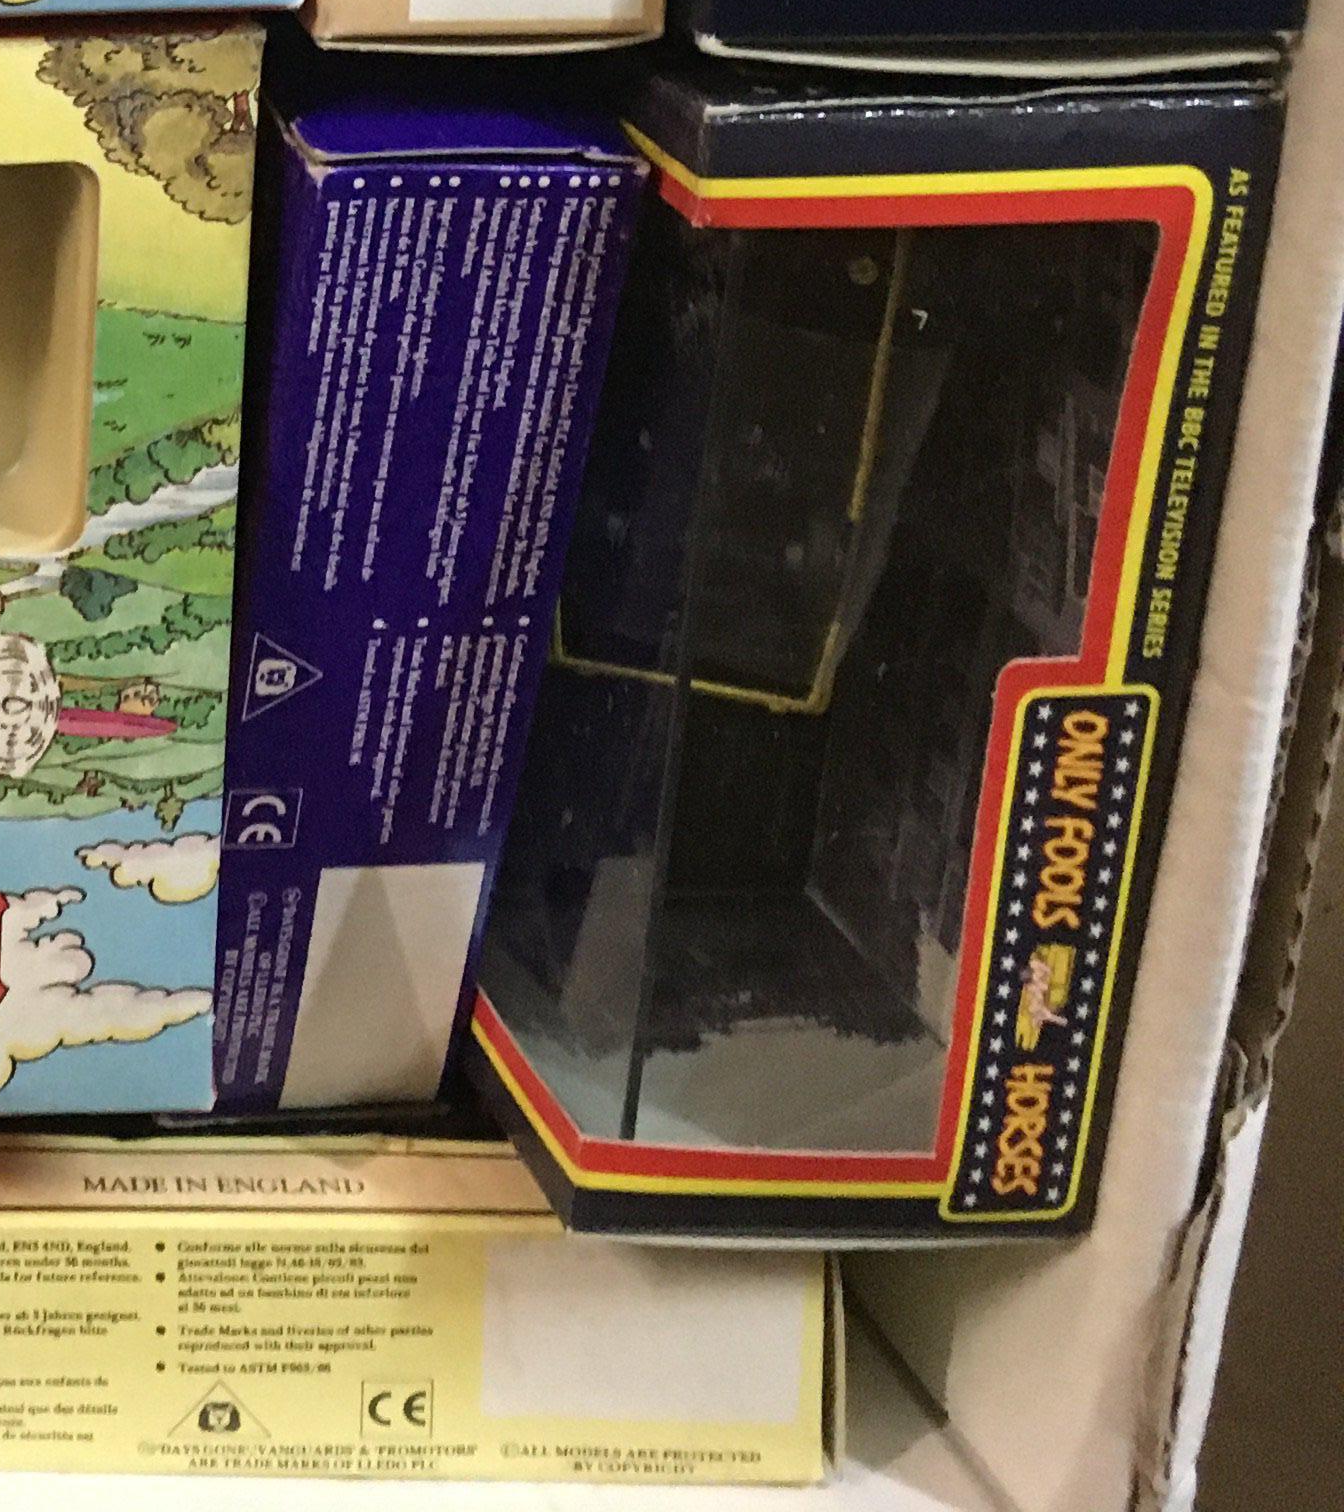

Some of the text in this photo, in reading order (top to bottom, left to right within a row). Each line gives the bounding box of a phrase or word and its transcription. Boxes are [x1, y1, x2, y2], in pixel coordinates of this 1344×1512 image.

[1142, 167, 1251, 658] AS FEATURED IN THE BBC TELEVISION SERIES
[1051, 710, 1109, 809] ONLY
[1032, 817, 1095, 929] FOOLS
[80, 1173, 364, 1194] MADE IN ENGLAND
[991, 1063, 1053, 1195] HORSES
